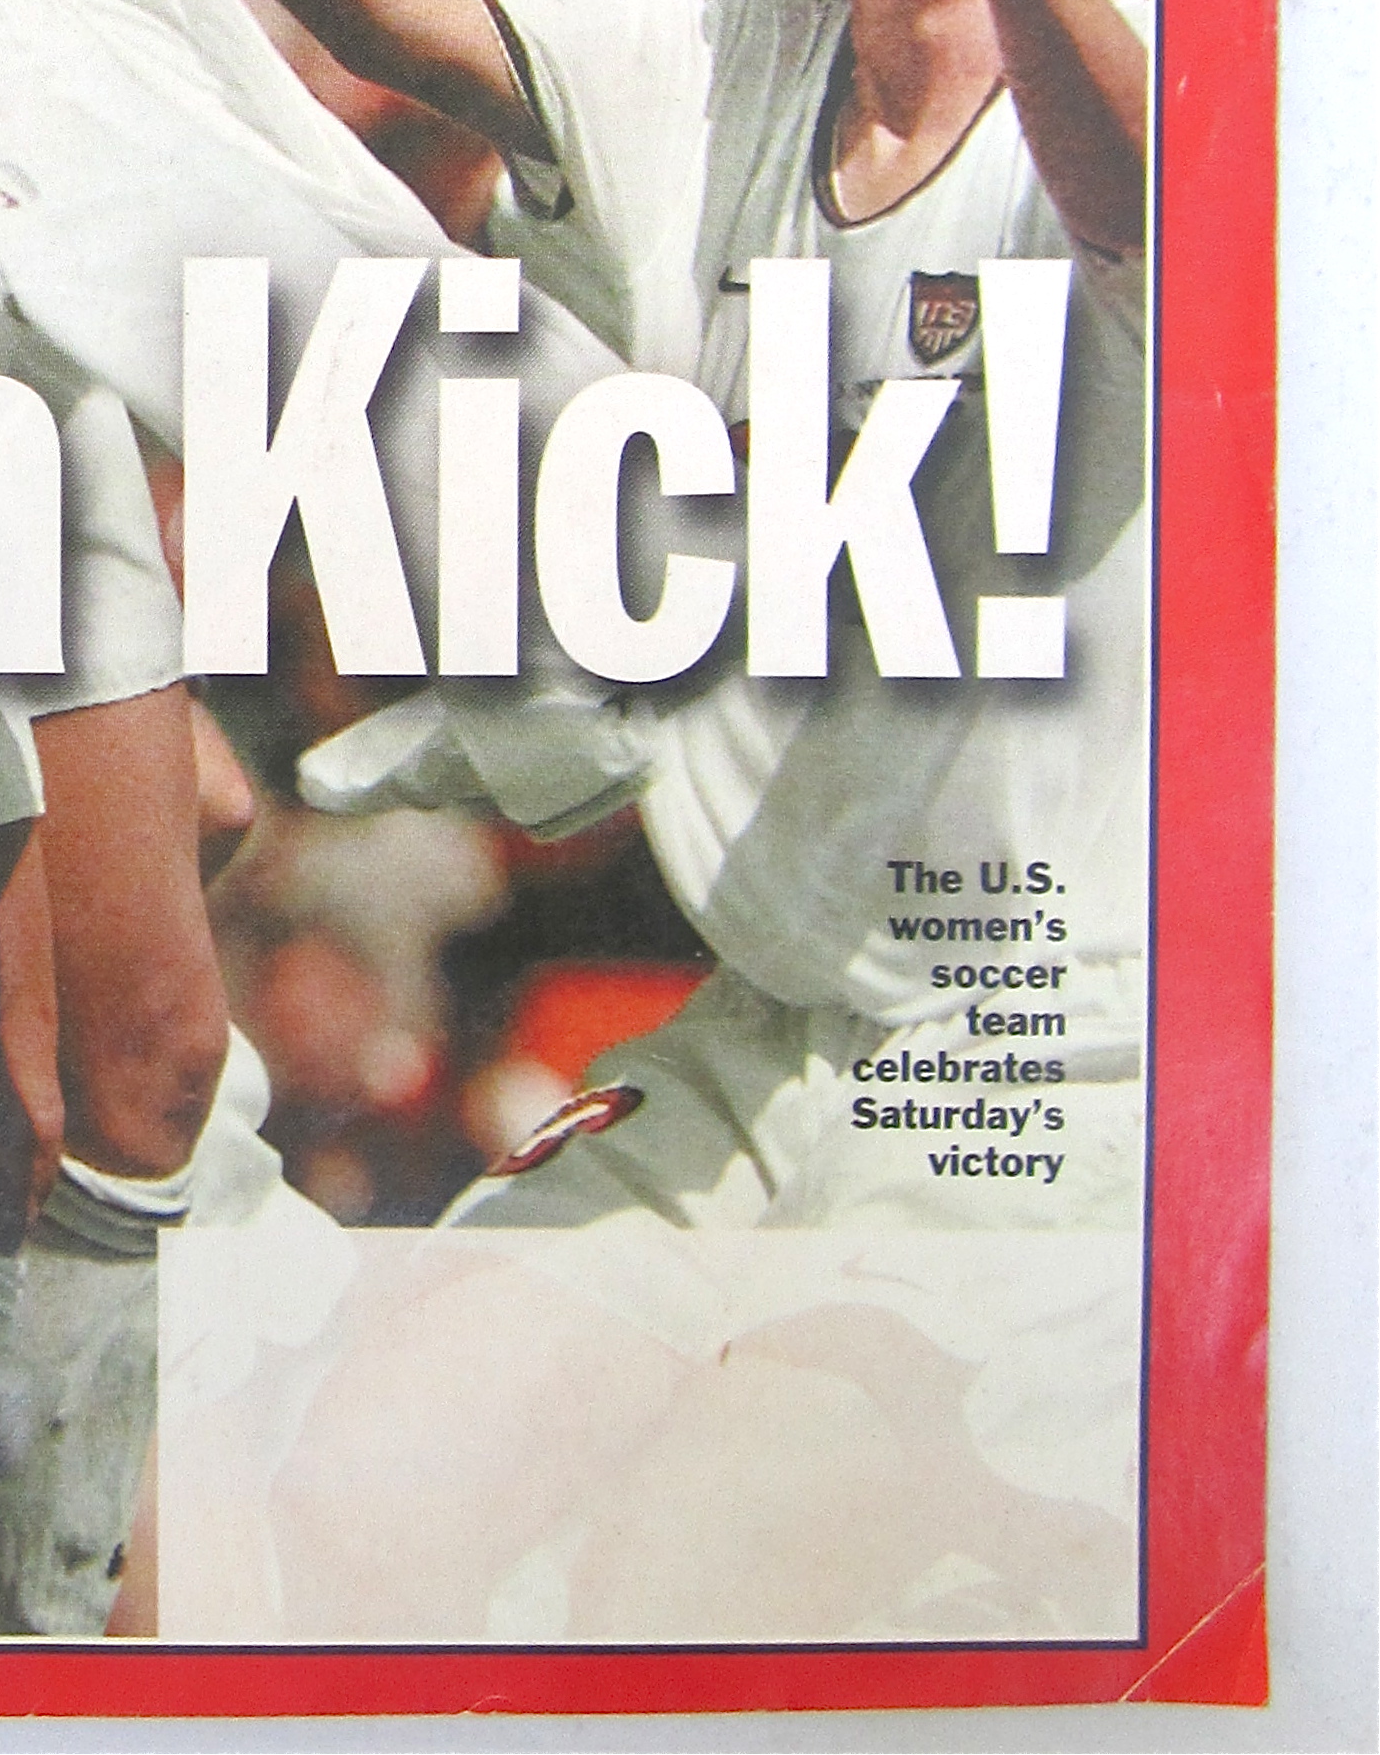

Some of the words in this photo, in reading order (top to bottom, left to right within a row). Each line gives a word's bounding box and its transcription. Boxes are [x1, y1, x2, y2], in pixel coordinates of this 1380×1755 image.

[183, 257, 1073, 682] Kick!
[886, 860, 963, 894] The
[980, 861, 1066, 894] U.S.
[888, 910, 1068, 942] women's
[931, 964, 1068, 989] soccer
[966, 1005, 1065, 1036] team
[852, 1050, 1066, 1083] celebrates
[850, 1097, 1065, 1137] Saturday's
[928, 1144, 1065, 1184] victory
